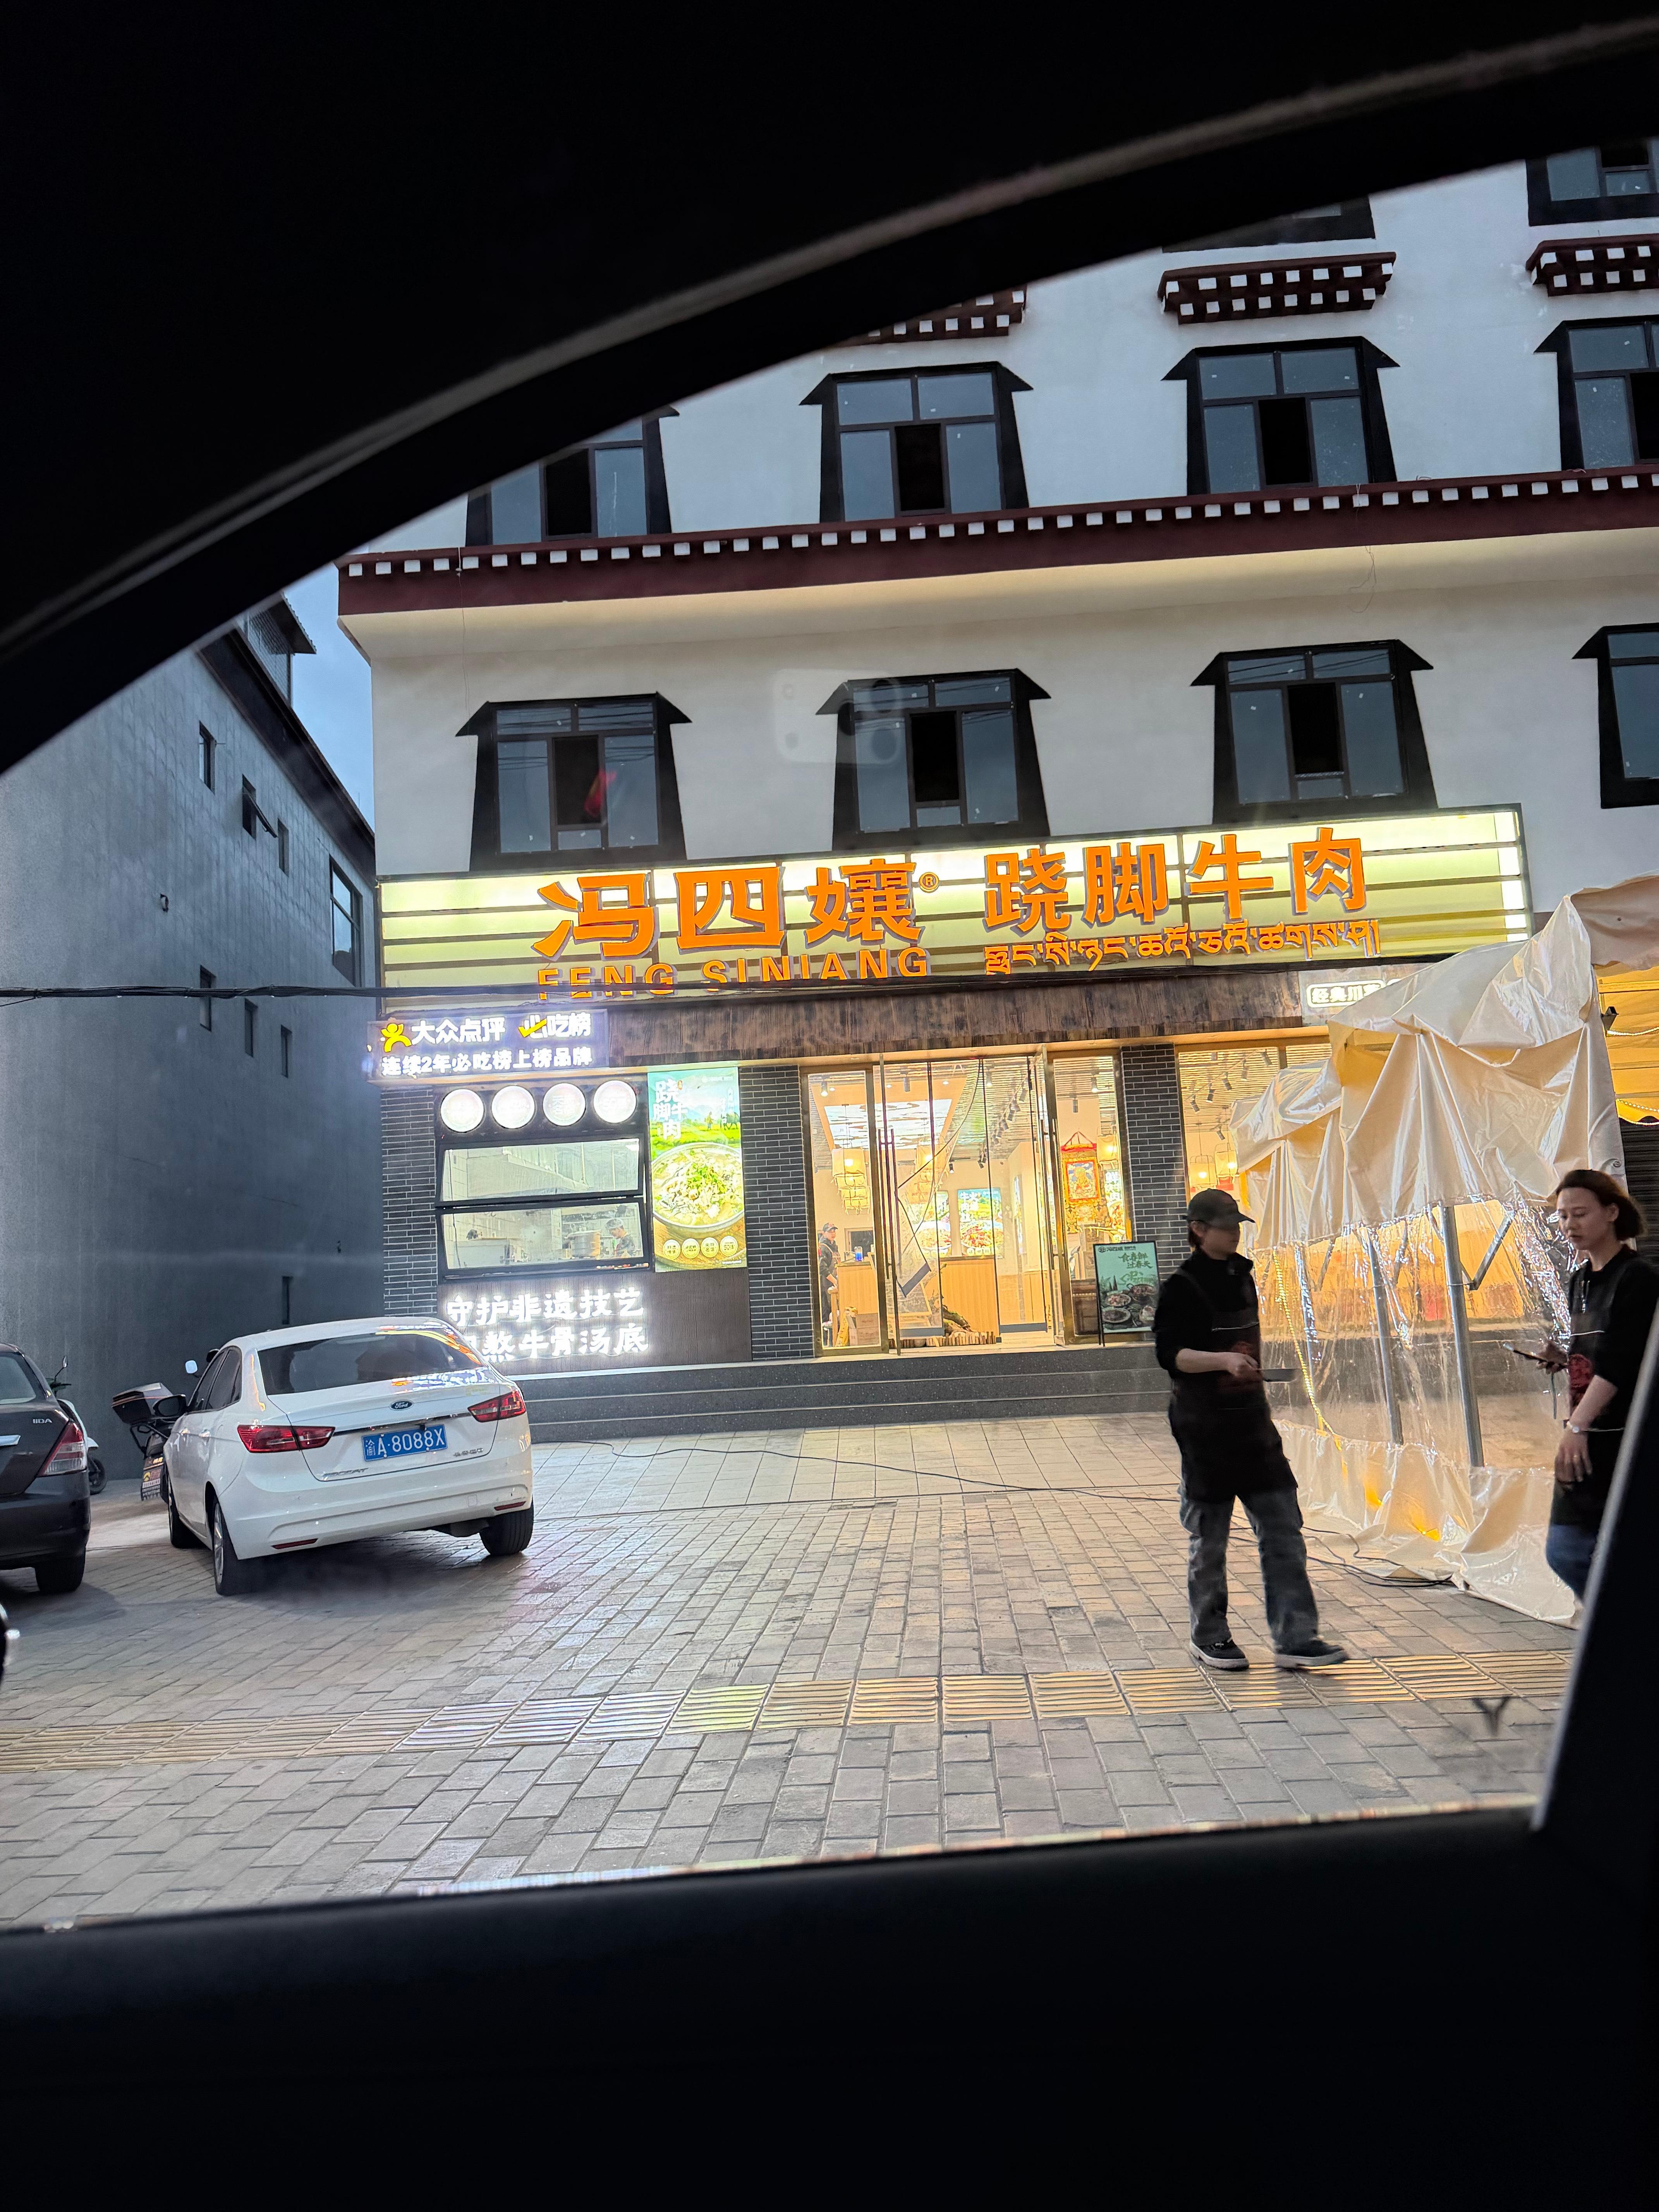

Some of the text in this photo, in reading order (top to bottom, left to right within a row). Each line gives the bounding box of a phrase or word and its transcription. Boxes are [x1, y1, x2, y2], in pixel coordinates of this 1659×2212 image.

[531, 858, 924, 960] 冯四孃
[984, 827, 1367, 932] 跷脚牛肉
[538, 948, 927, 1000] FENG SINIANG
[411, 1012, 591, 1045] 大众点评 必吃榜
[381, 1046, 592, 1077] 连续2年必吃榜上榜品牌
[447, 1287, 644, 1326] 守护非遗技艺
[394, 1401, 409, 1409] Ford
